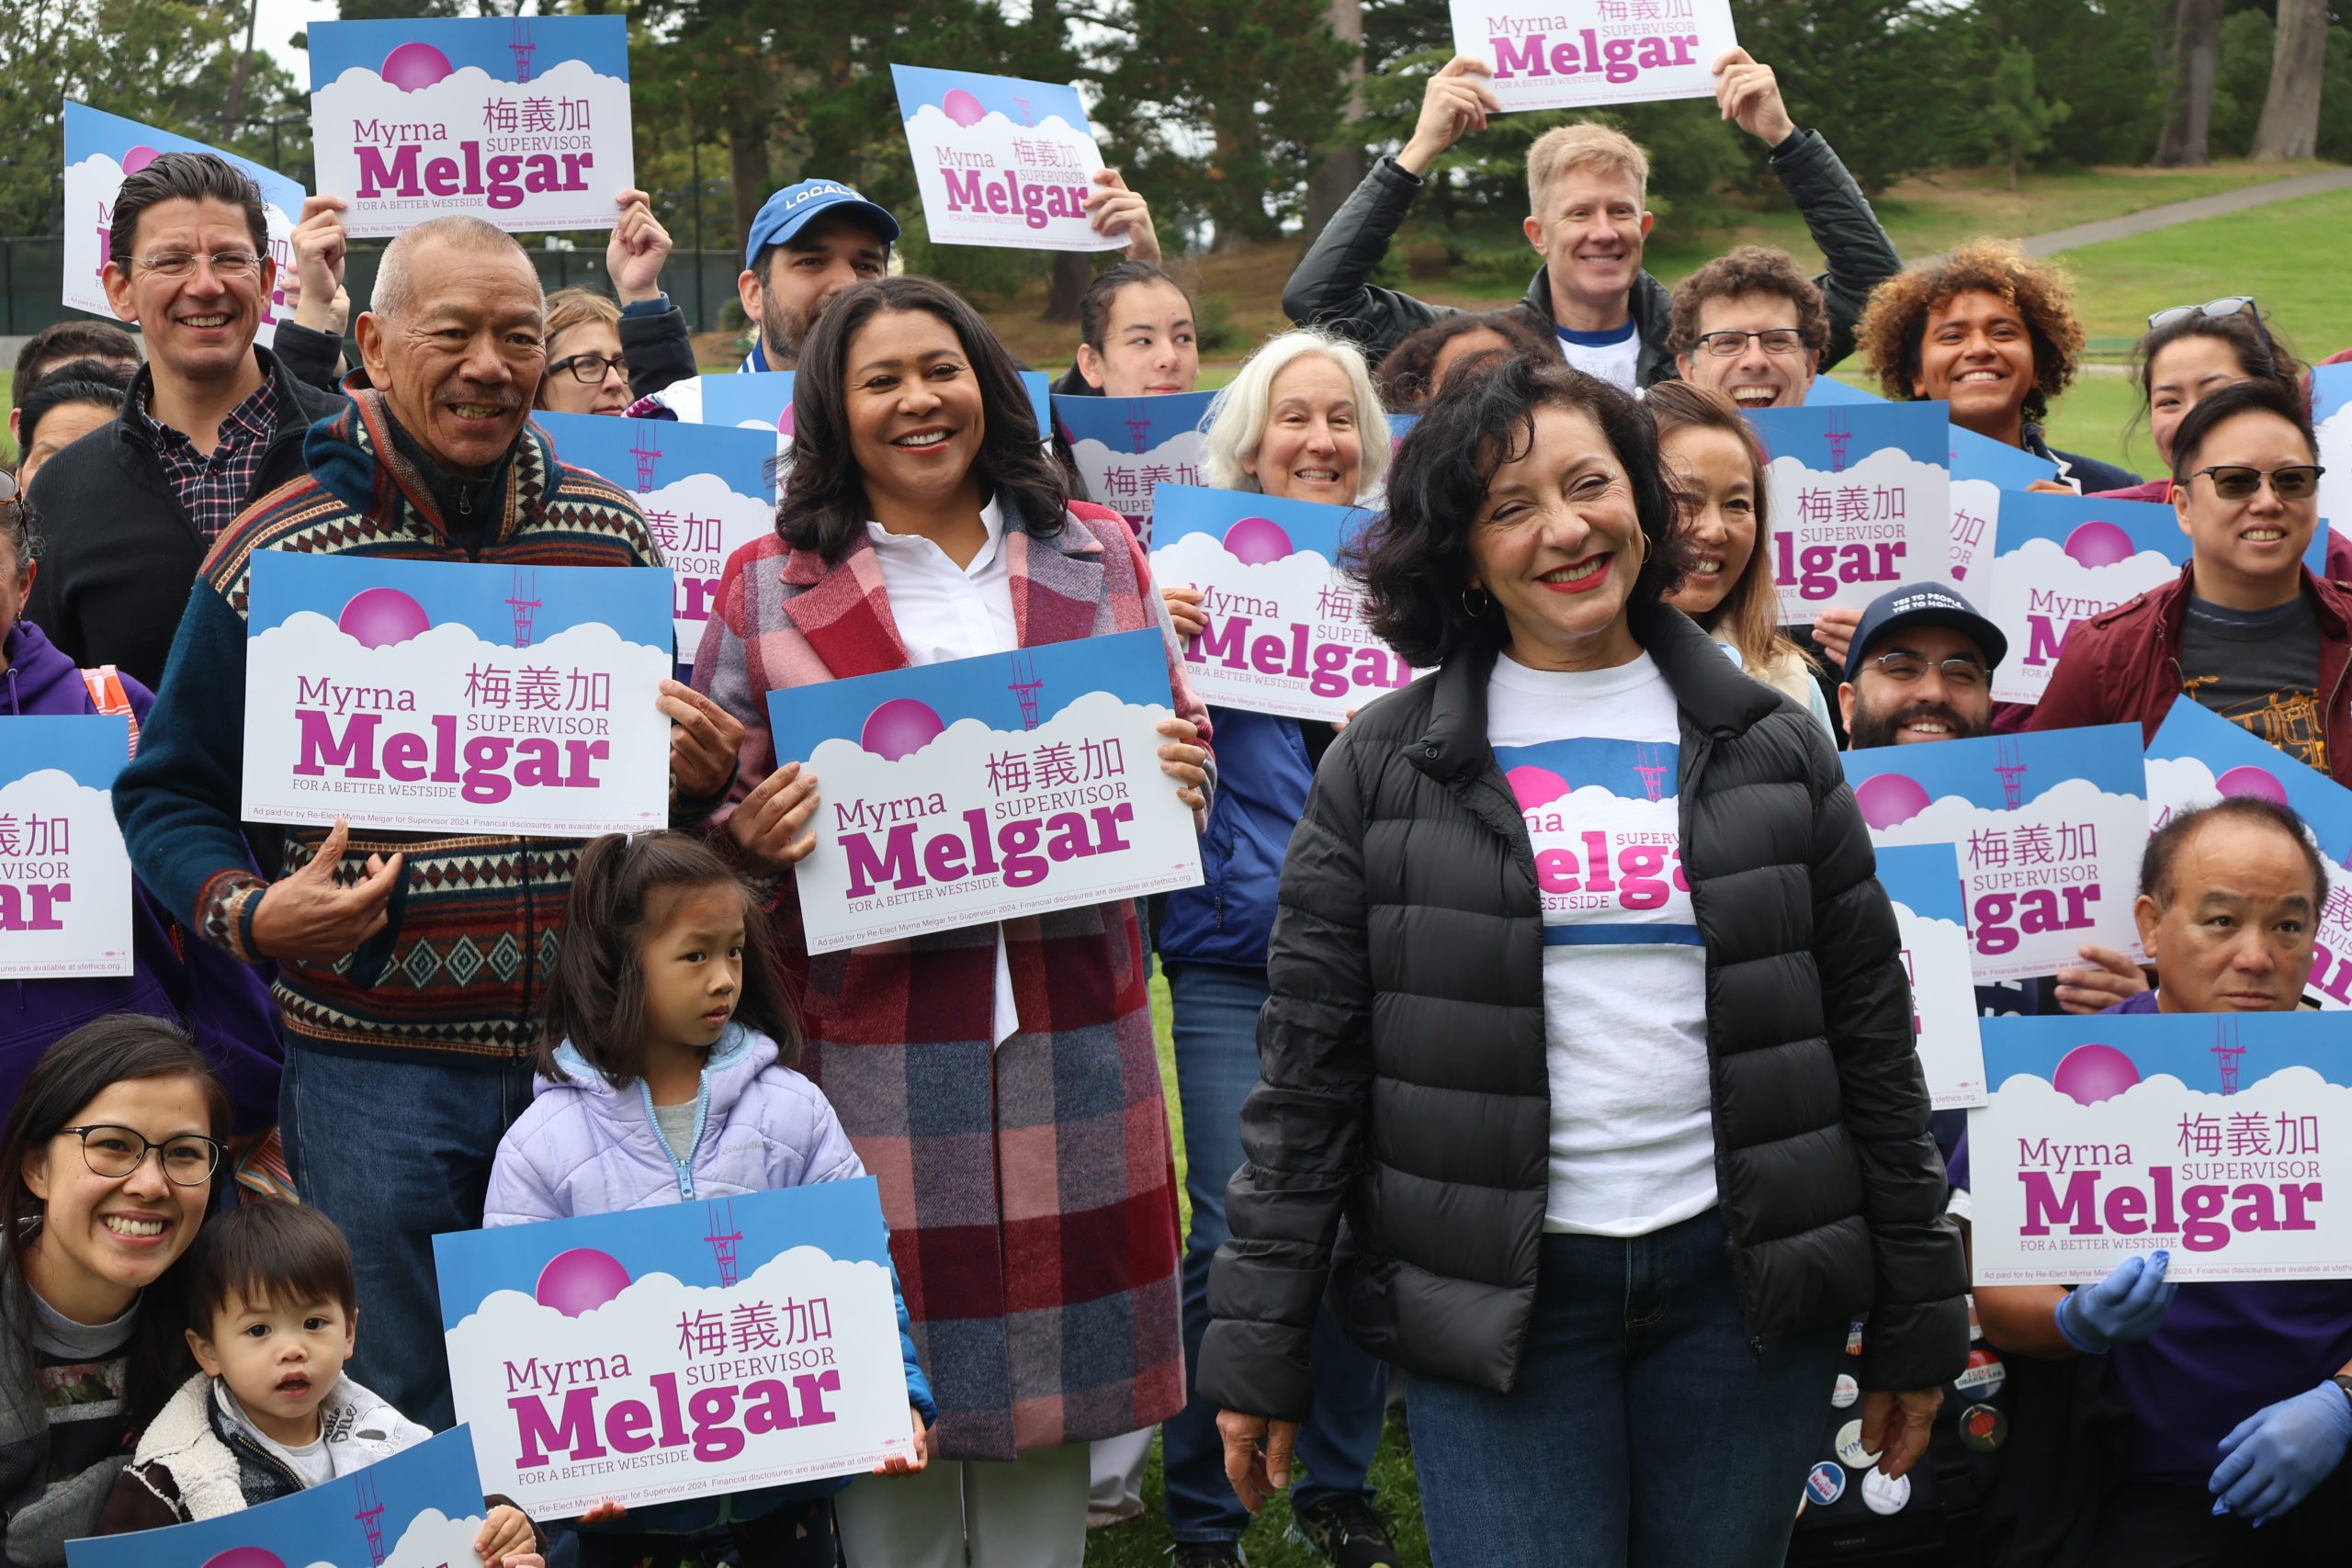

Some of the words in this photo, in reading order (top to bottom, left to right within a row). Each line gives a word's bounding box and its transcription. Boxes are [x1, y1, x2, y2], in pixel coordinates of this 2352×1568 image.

[1486, 14, 1567, 39] Myrna
[1600, 19, 1697, 37] SUPERVISOR
[1487, 28, 1700, 83] Melgar
[481, 96, 592, 133] 梅義加
[352, 118, 447, 149] Myrna
[485, 135, 594, 152] SUPERVISOR
[1012, 136, 1081, 167] 梅義加
[353, 140, 594, 209] Melgar
[934, 146, 995, 171] Myrna
[1019, 169, 1086, 184] SUPERVISOR
[356, 200, 377, 210] FOR
[379, 200, 387, 209] A
[390, 198, 428, 209] BETTER
[431, 197, 483, 208] WESTSIDE
[940, 168, 1088, 229] Melgar
[1797, 484, 1905, 524] 梅義加
[645, 508, 721, 554] 義加
[1800, 523, 1906, 543] SUPERVISOR
[1774, 531, 1906, 601] lgar
[1187, 582, 1279, 618] Myrna
[1893, 597, 1910, 607] YES
[1911, 593, 1926, 602] TO
[1893, 604, 1911, 614] YES
[1317, 625, 1376, 645] SUPER
[463, 661, 609, 713] 梅義加
[1184, 664, 1201, 676] OR
[1203, 667, 1211, 676] A
[1213, 669, 1251, 682] BETTER
[1253, 674, 1306, 691] WESTSIDE
[296, 676, 416, 716] Myrna
[466, 712, 610, 737] SUPERVISOR
[292, 710, 610, 803] Melgar
[984, 737, 1125, 796] 梅義加
[292, 778, 318, 790] FOR
[321, 780, 331, 791] A
[334, 781, 384, 794] BETTER
[388, 784, 456, 797] WESTSIDE
[993, 780, 1129, 819] SUPERVISOR
[252, 806, 264, 815] Ad
[265, 807, 282, 818] paid
[283, 808, 294, 817] for
[295, 809, 305, 820] by
[307, 810, 340, 819] Re-Elect
[341, 812, 366, 823] Myrna
[367, 814, 394, 825] Melgar
[395, 816, 405, 824] for
[407, 816, 447, 828] Supervisor
[449, 818, 471, 827] 2024.
[473, 818, 508, 828] Financial
[508, 819, 552, 829] disclosures
[568, 821, 602, 830] available
[832, 793, 947, 833] Myrna
[837, 802, 1134, 899] Melgar
[1617, 833, 1682, 846] SUPER
[1966, 822, 2097, 870] 梅義加
[0, 862, 70, 879] VISOR
[1534, 831, 1690, 910] elg
[1973, 863, 2099, 892] SUPERVISOR
[847, 898, 872, 913] FOR
[874, 897, 884, 908] A
[886, 887, 933, 906] BETTER
[934, 875, 999, 897] WESTSIDE
[1541, 896, 1610, 910] ESTSIDE
[816, 937, 828, 947] Ad
[828, 934, 845, 947] paid
[844, 932, 855, 942] for
[855, 931, 866, 942] by
[866, 924, 898, 938] Re-Elect
[898, 920, 922, 934] Myrna
[922, 916, 947, 930] Melgar
[947, 914, 957, 923] for
[958, 907, 997, 923] Supervisor
[997, 903, 1019, 914] 2024.
[1019, 897, 1053, 910] Financial
[1052, 889, 1093, 904] disclosures
[1107, 881, 1140, 894] available
[1140, 879, 1149, 888] at
[1962, 884, 2101, 955] gar
[34, 963, 67, 971] available
[69, 962, 76, 970] at
[2177, 1111, 2319, 1156] 梅義加
[2017, 1137, 2133, 1174] Myrna
[2181, 1160, 2322, 1179] SUPERVISOR
[2017, 1165, 2324, 1251] Melgar
[2020, 1239, 2045, 1251] FOR
[2048, 1239, 2057, 1250] A
[2060, 1238, 2109, 1250] BETTER
[2111, 1236, 2177, 1249] WESTSIDE
[1984, 1270, 1995, 1279] Ad
[1996, 1270, 2012, 1280] paid
[2013, 1270, 2023, 1279] for
[2025, 1269, 2034, 1280] by
[2036, 1269, 2068, 1278] Re-Elect
[2069, 1269, 2092, 1280] Myrna
[2196, 1266, 2231, 1275] Financial
[2230, 1265, 2273, 1274] disclosures
[2288, 1264, 2322, 1272] available
[2322, 1263, 2330, 1271] at
[675, 1297, 831, 1359] 梅義加
[503, 1353, 632, 1396] Myrna
[684, 1346, 837, 1385] SUPERVISOR
[506, 1370, 842, 1470] Melgar
[1839, 1438, 1861, 1458] YIM
[517, 1470, 546, 1485] FOR
[548, 1468, 559, 1481] A
[561, 1460, 615, 1479] BETTER
[616, 1449, 689, 1471] WESTSIDE
[526, 1506, 537, 1518] by
[538, 1500, 574, 1514] Re-Elect
[574, 1495, 601, 1511] Myrna
[629, 1490, 641, 1500] for
[642, 1483, 685, 1501] Supervisor
[686, 1480, 710, 1492] 2024.
[710, 1473, 748, 1488] Financial
[748, 1467, 794, 1482] disclosures
[794, 1466, 809, 1474] are
[809, 1458, 846, 1472] available
[846, 1456, 855, 1466] at
